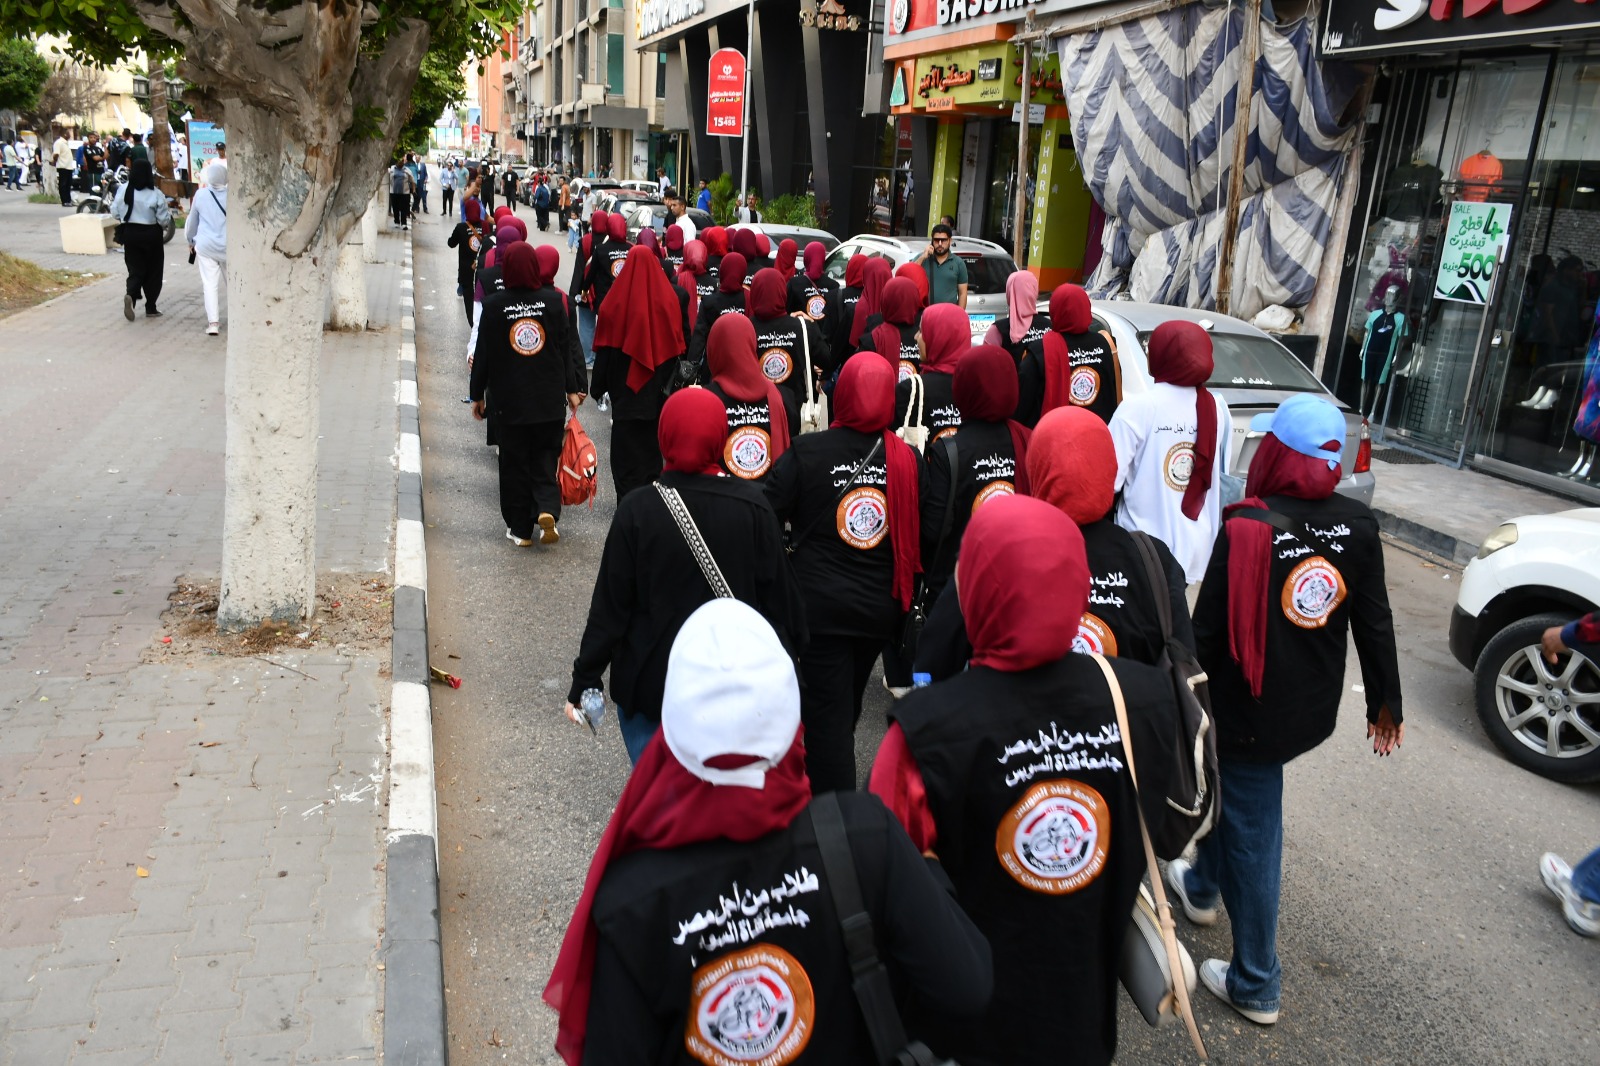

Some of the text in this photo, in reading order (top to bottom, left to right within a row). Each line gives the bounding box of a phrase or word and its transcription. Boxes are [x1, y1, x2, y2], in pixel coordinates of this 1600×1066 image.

[203, 147, 217, 155] 202
[1033, 129, 1051, 257] PHARMACY
[1454, 204, 1471, 214] SALE
[1459, 207, 1504, 241] 4 قطع
[1457, 252, 1496, 281] 500
[531, 301, 545, 309] طلاب
[507, 311, 524, 320] السويس
[783, 331, 797, 340] طلاب
[1089, 347, 1103, 356] طلاب
[747, 405, 758, 415] من
[930, 408, 944, 417] مصر
[933, 417, 951, 426] السويس
[1154, 425, 1172, 434] مصر
[830, 464, 851, 474] مصر
[864, 465, 875, 474] من
[972, 458, 988, 469] مصر
[999, 457, 1009, 467] من
[976, 469, 996, 480] السويس
[843, 491, 861, 508] السويس
[841, 528, 850, 542] SUEZ
[851, 539, 867, 547] CANAL
[1324, 523, 1351, 539] طلاب
[1095, 571, 1128, 589] طلاب
[1090, 589, 1125, 608] جامعة
[1058, 729, 1084, 751] من
[997, 739, 1034, 764] مصر
[1005, 749, 1123, 787] جامعة قناة السويس
[1002, 852, 1022, 876] SUEZ
[1021, 873, 1054, 891] CANAL
[1057, 847, 1105, 890] UNIVERSITY
[771, 866, 819, 904] طلاب
[741, 888, 770, 916] من
[764, 904, 810, 929] جامعة
[672, 909, 716, 945] مصر
